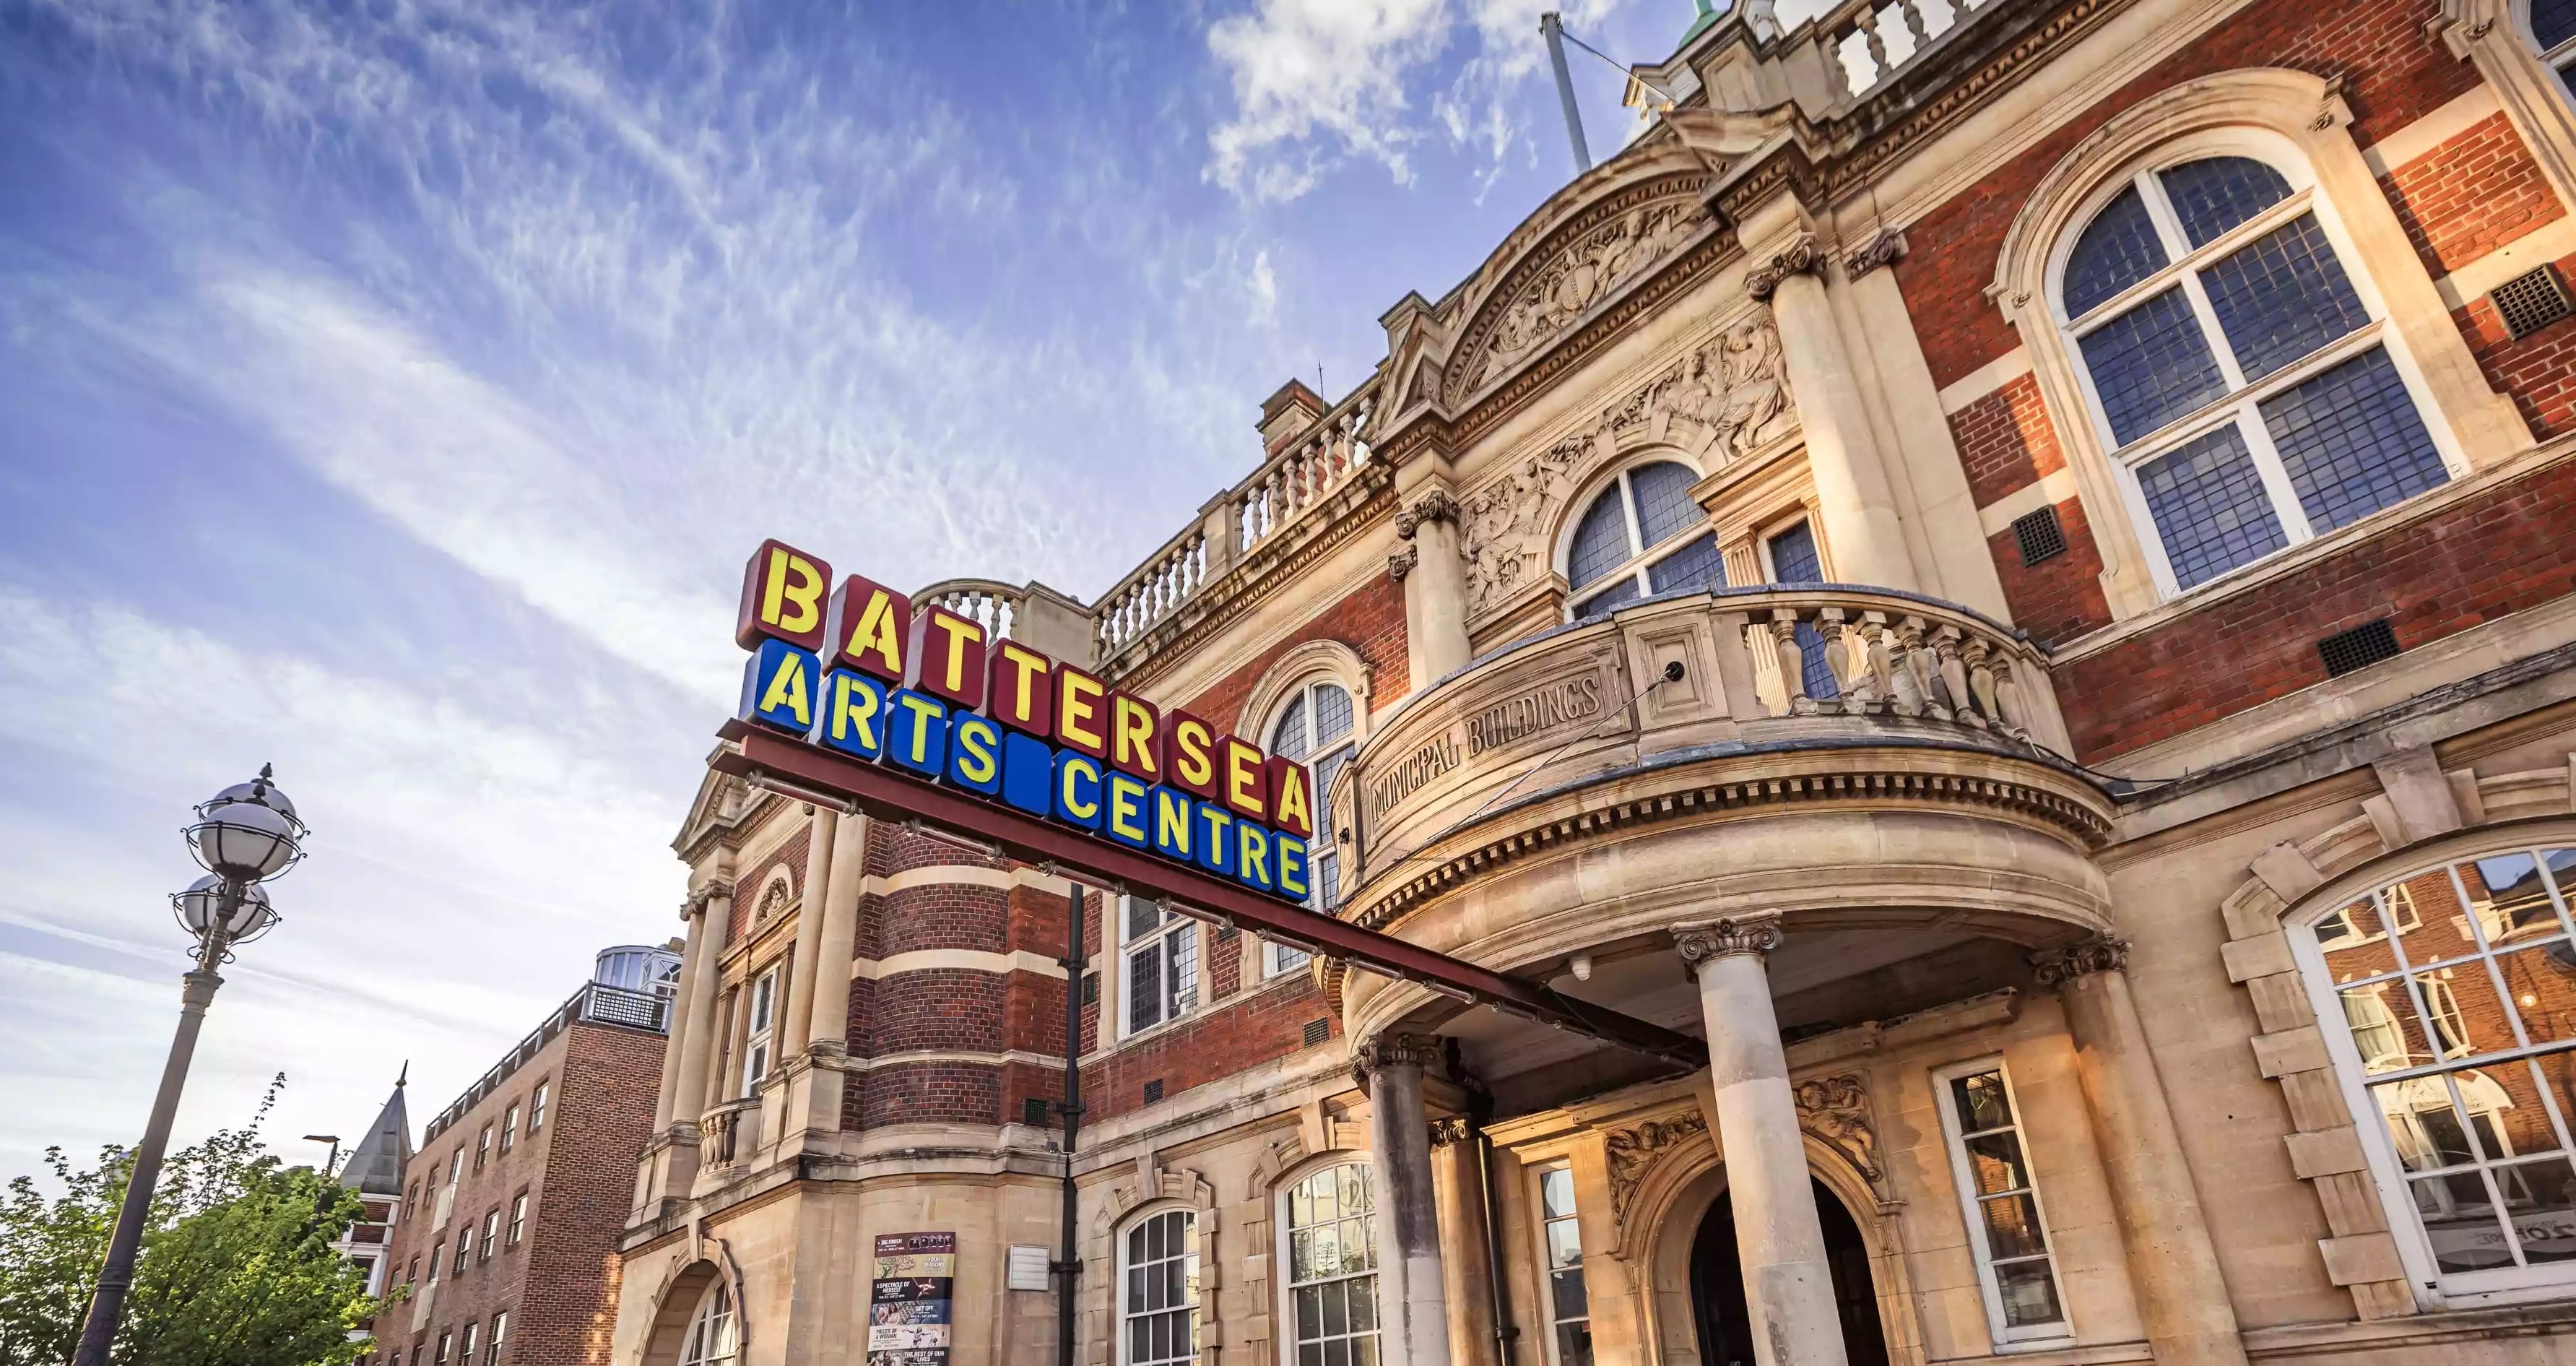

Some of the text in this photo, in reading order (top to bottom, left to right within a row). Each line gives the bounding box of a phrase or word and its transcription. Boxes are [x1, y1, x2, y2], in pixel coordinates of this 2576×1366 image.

[759, 651, 1306, 895] ARTS CENTRE
[760, 547, 1311, 834] BATTERSEA
[1372, 675, 1600, 822] MUNICIPAL BUILDINGS
